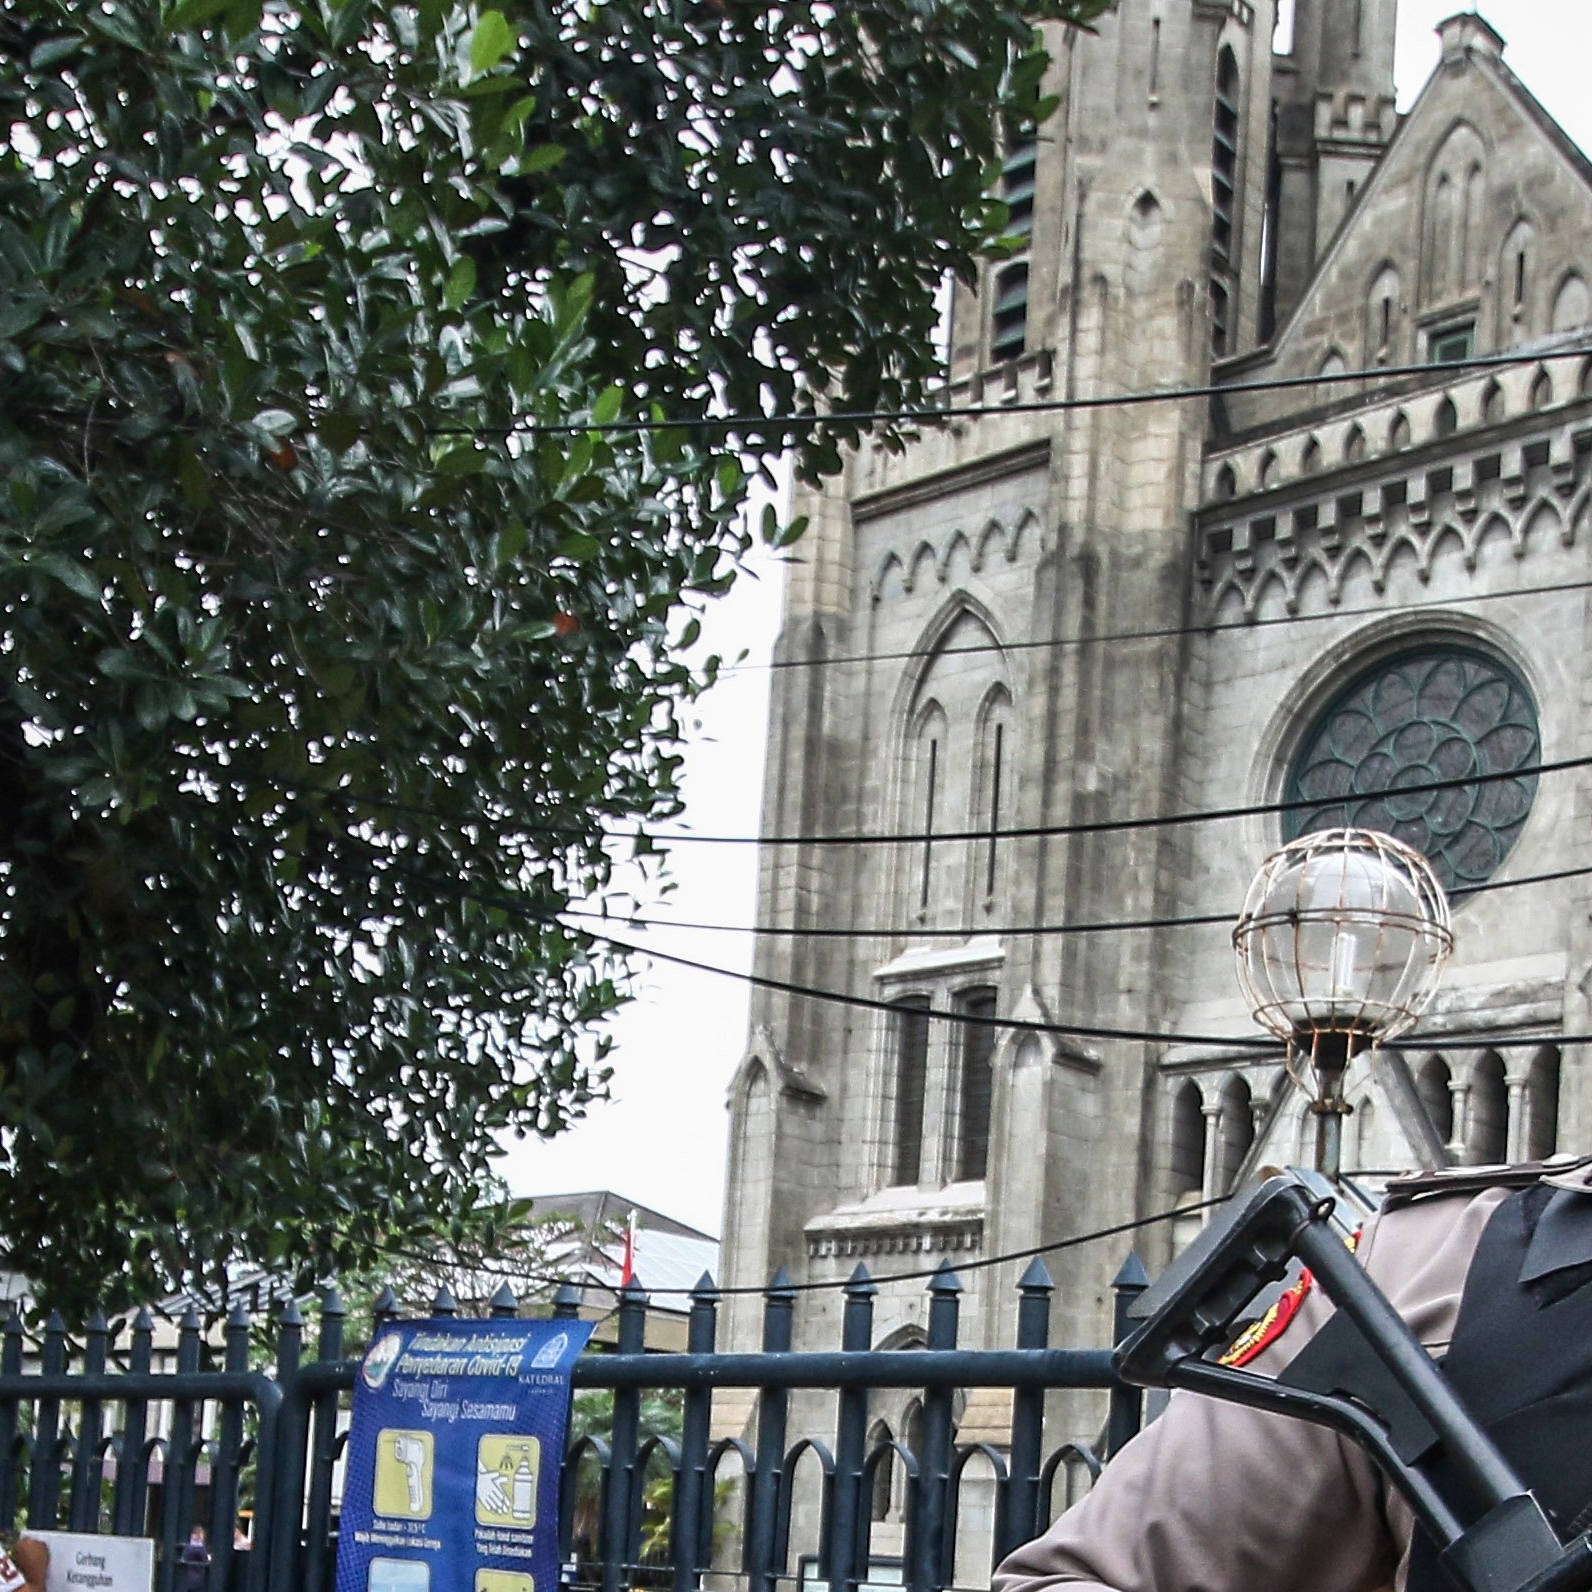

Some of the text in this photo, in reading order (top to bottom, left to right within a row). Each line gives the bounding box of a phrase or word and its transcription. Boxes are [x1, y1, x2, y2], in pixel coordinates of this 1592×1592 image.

[395, 1354, 524, 1379] Penyebaran Covid-19
[392, 1376, 449, 1402] Sayangi Diri
[518, 1373, 564, 1386] KATEDRAL
[421, 1398, 516, 1423] Sayangi Sesamamu
